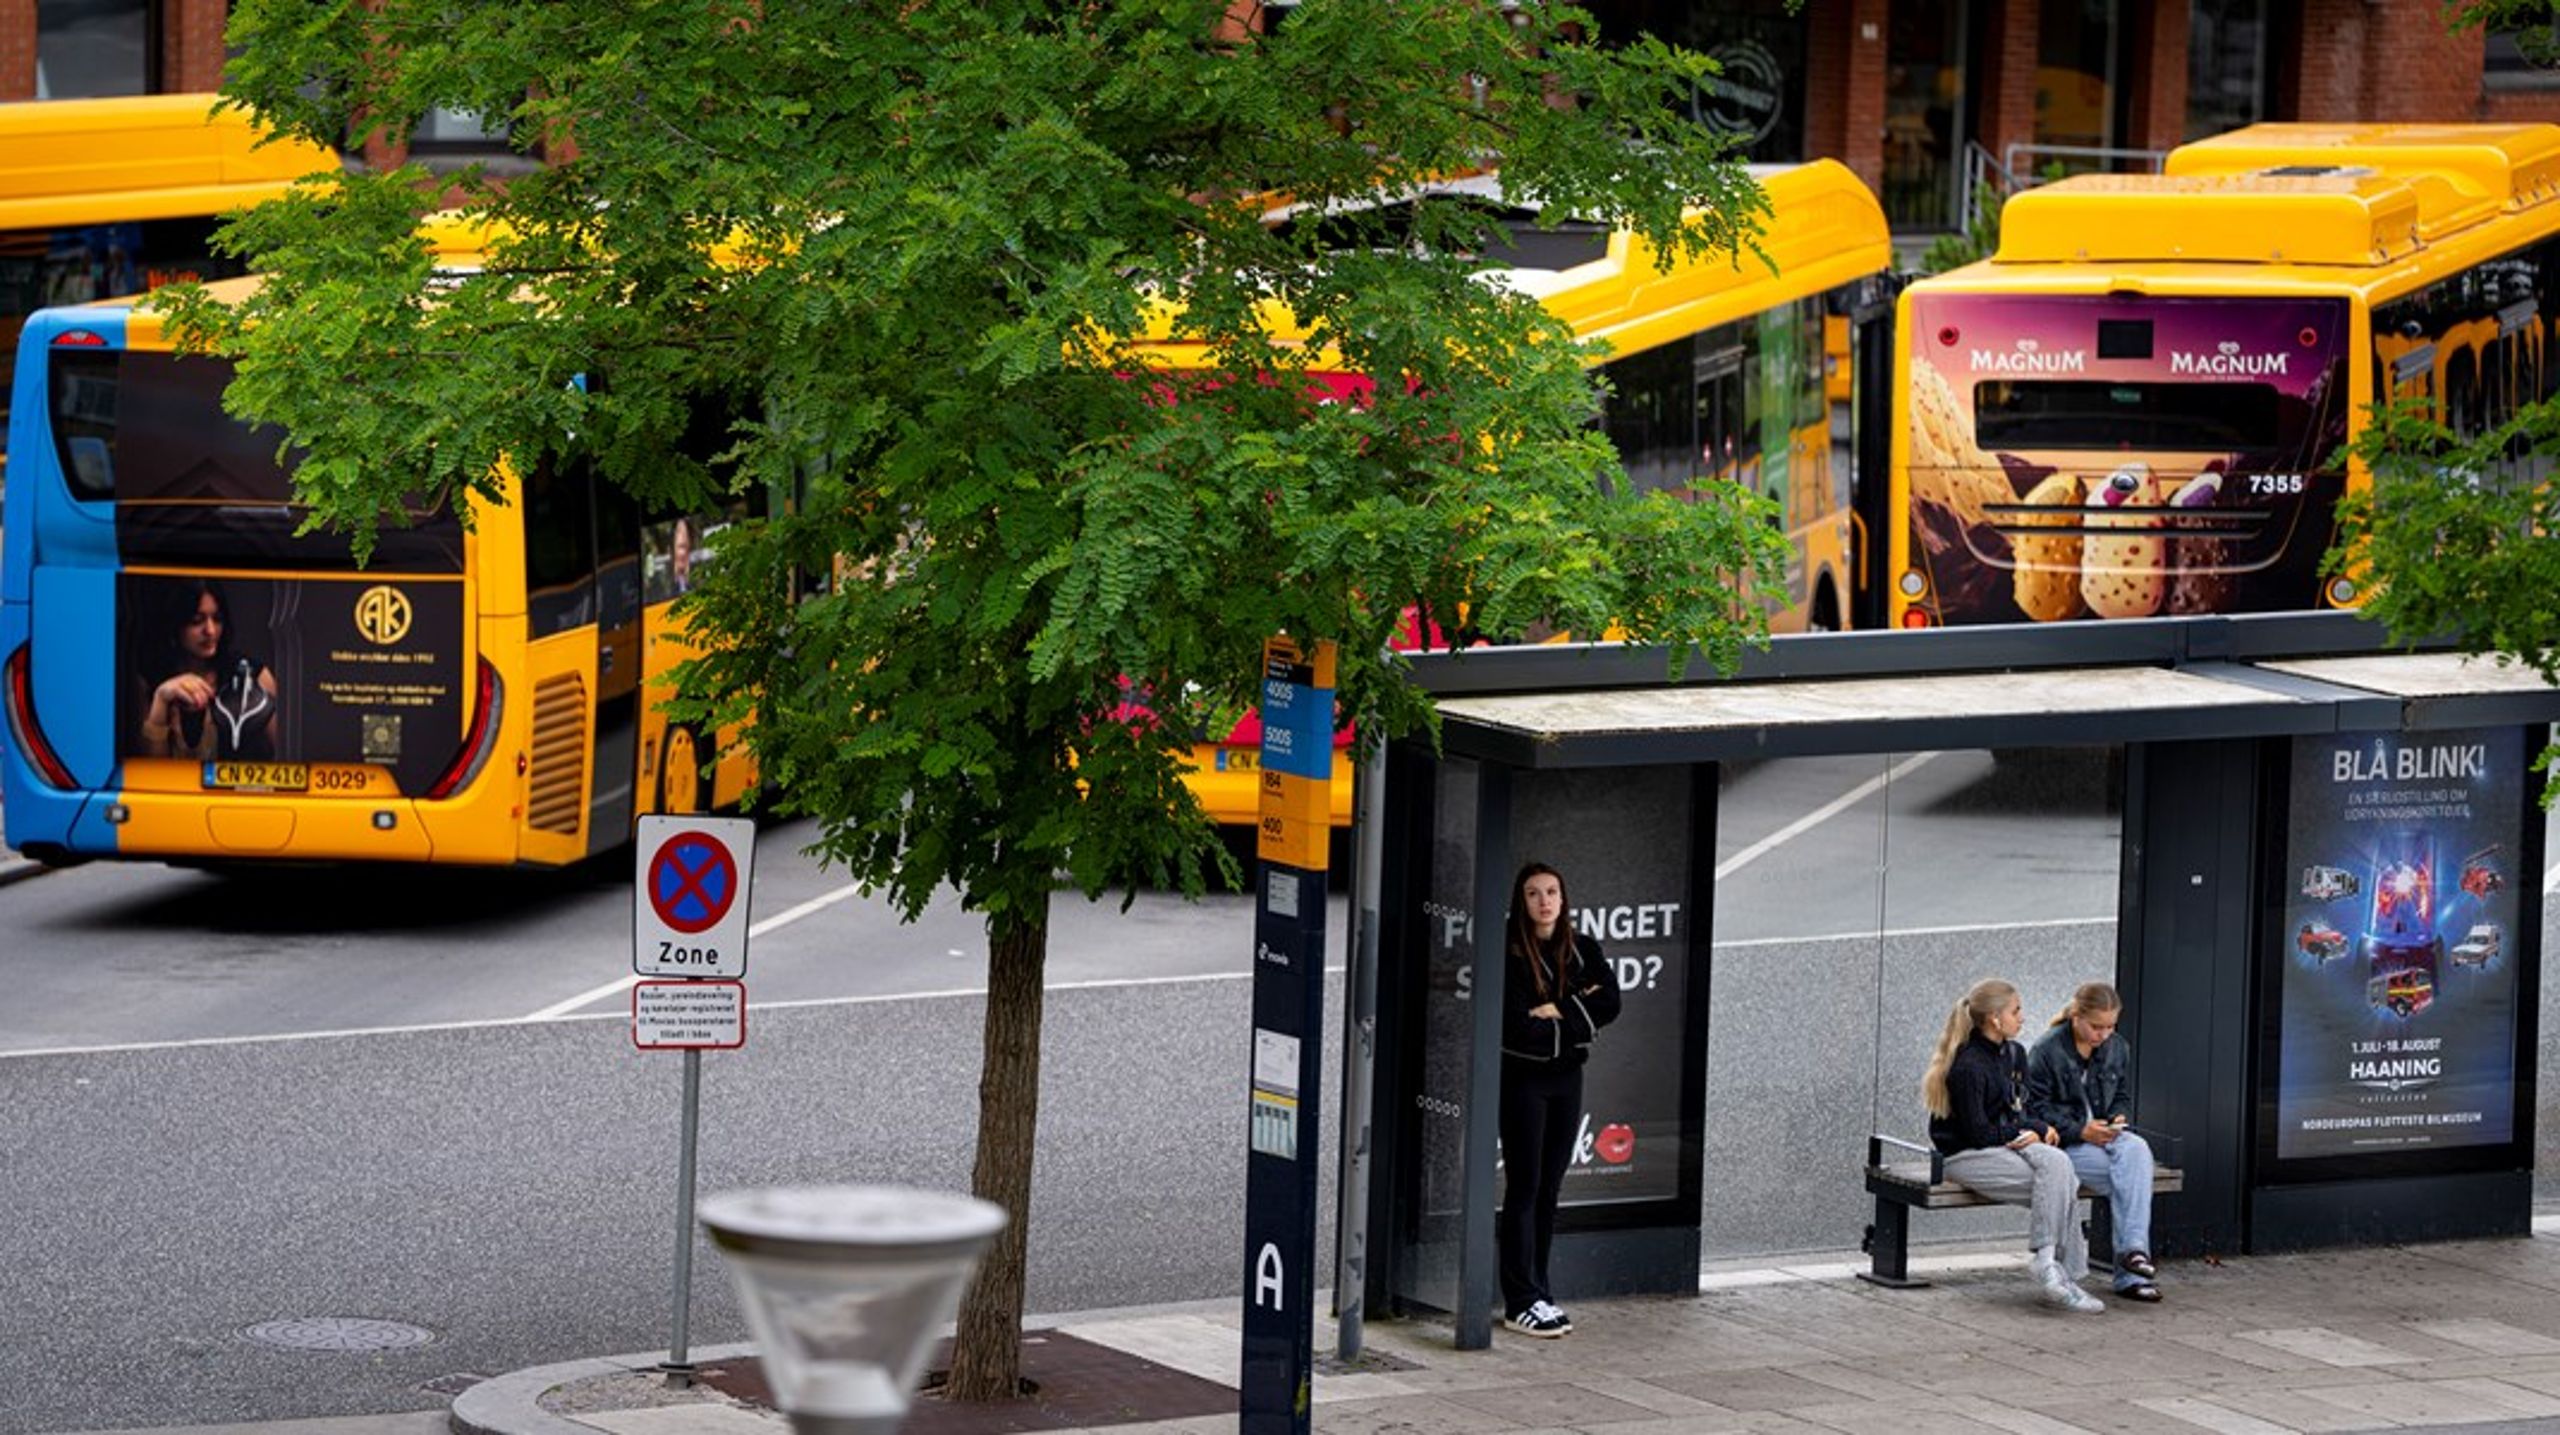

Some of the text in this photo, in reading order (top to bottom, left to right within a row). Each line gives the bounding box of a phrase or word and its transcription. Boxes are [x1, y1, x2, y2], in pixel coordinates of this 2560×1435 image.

[1970, 348, 2086, 373] MAGNUM
[2171, 351, 2289, 374] MAGNUM
[2250, 475, 2303, 494] 7355
[355, 585, 413, 645] AK
[1267, 681, 1294, 701] 400S
[1264, 726, 1292, 747] 500S
[2333, 738, 2485, 782] BLÅ BLINK!
[216, 765, 304, 784] CN 92 416
[315, 770, 367, 790] 3029
[659, 941, 719, 965] Zone
[2401, 1037, 2442, 1051] AUGUST
[2350, 1058, 2442, 1080] HAANING
[2302, 1116, 2373, 1131] NORDEUROPAS
[2426, 1111, 2483, 1126] BILMUSEUM
[1256, 1242, 1283, 1311] A
